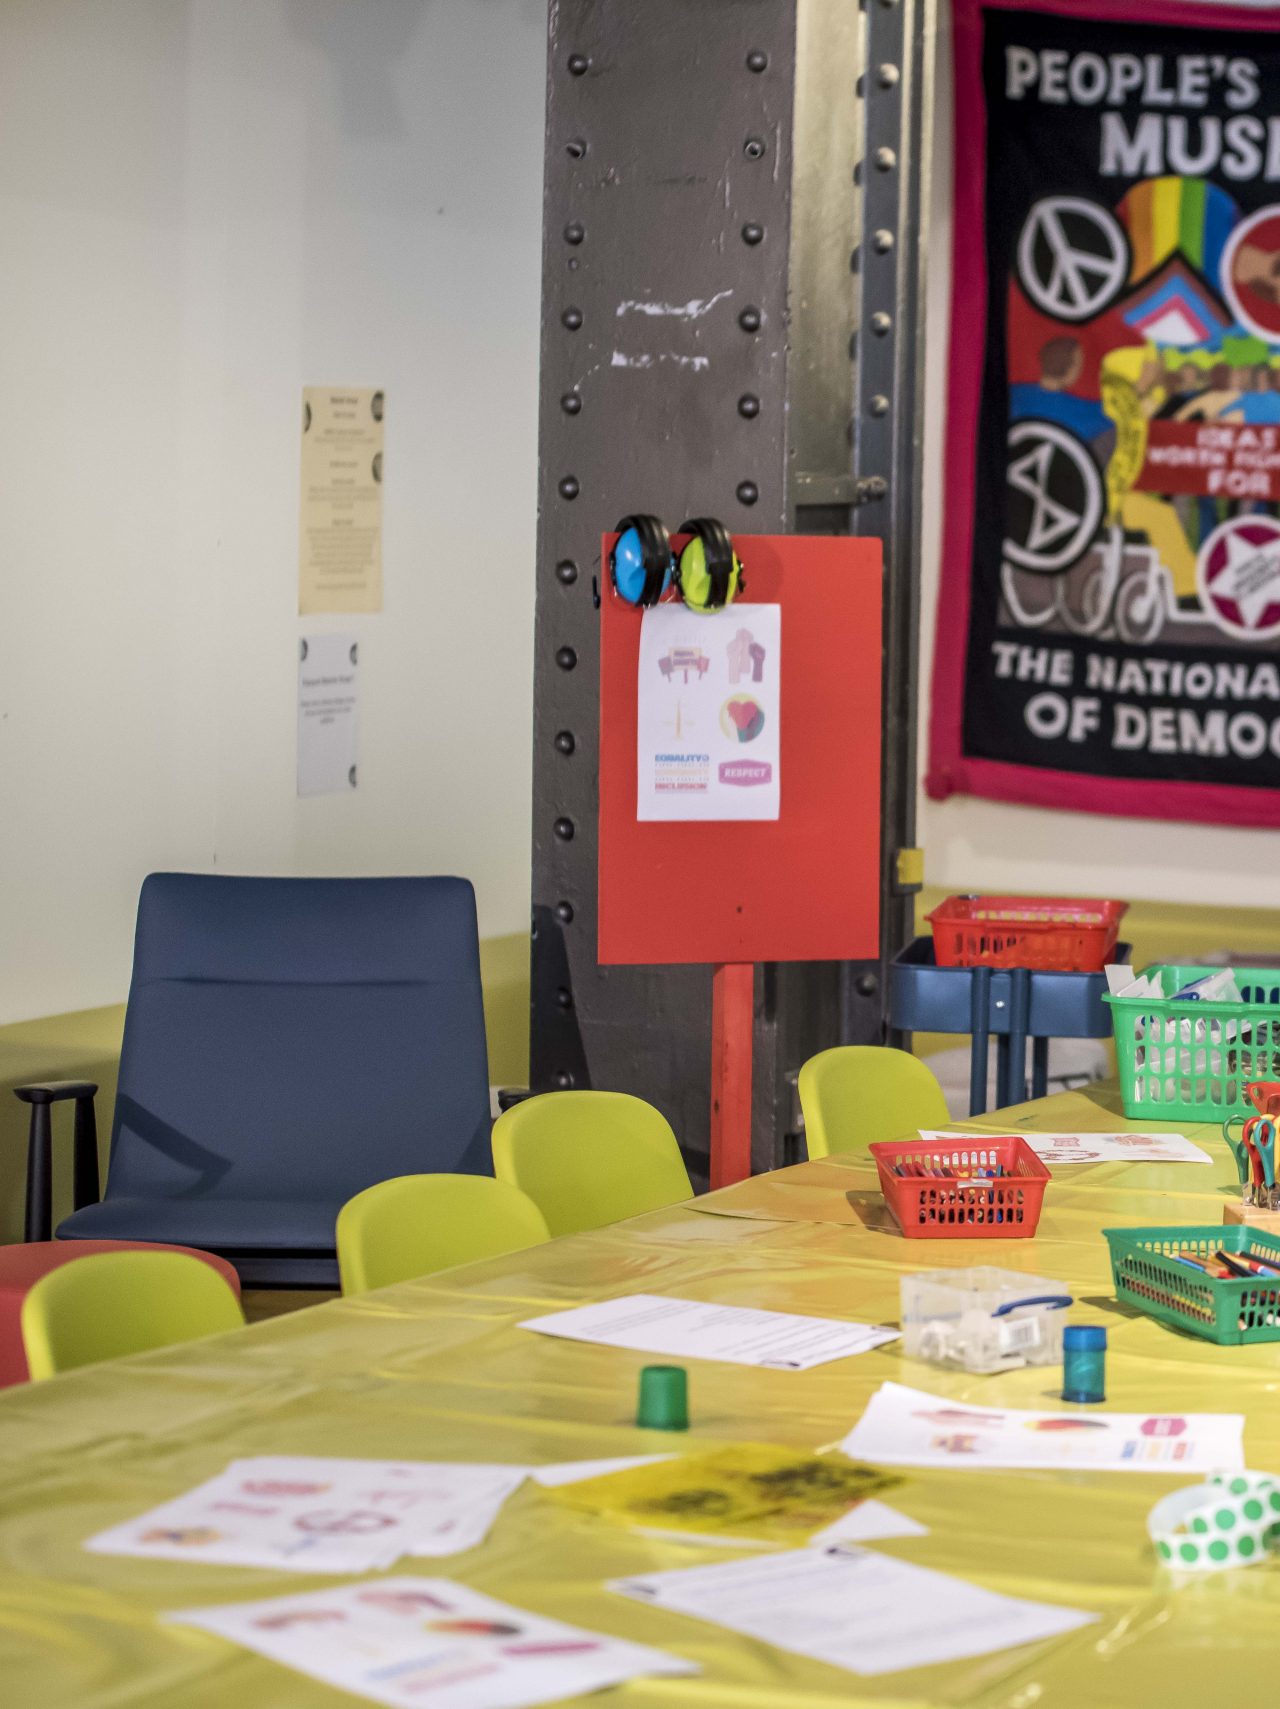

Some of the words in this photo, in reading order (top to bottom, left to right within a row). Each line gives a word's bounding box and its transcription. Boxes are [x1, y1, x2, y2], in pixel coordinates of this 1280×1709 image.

[1005, 44, 1260, 110] PEOPLE'S
[1207, 469, 1272, 497] FOR
[992, 642, 1073, 686] THE
[1023, 692, 1100, 743] OF
